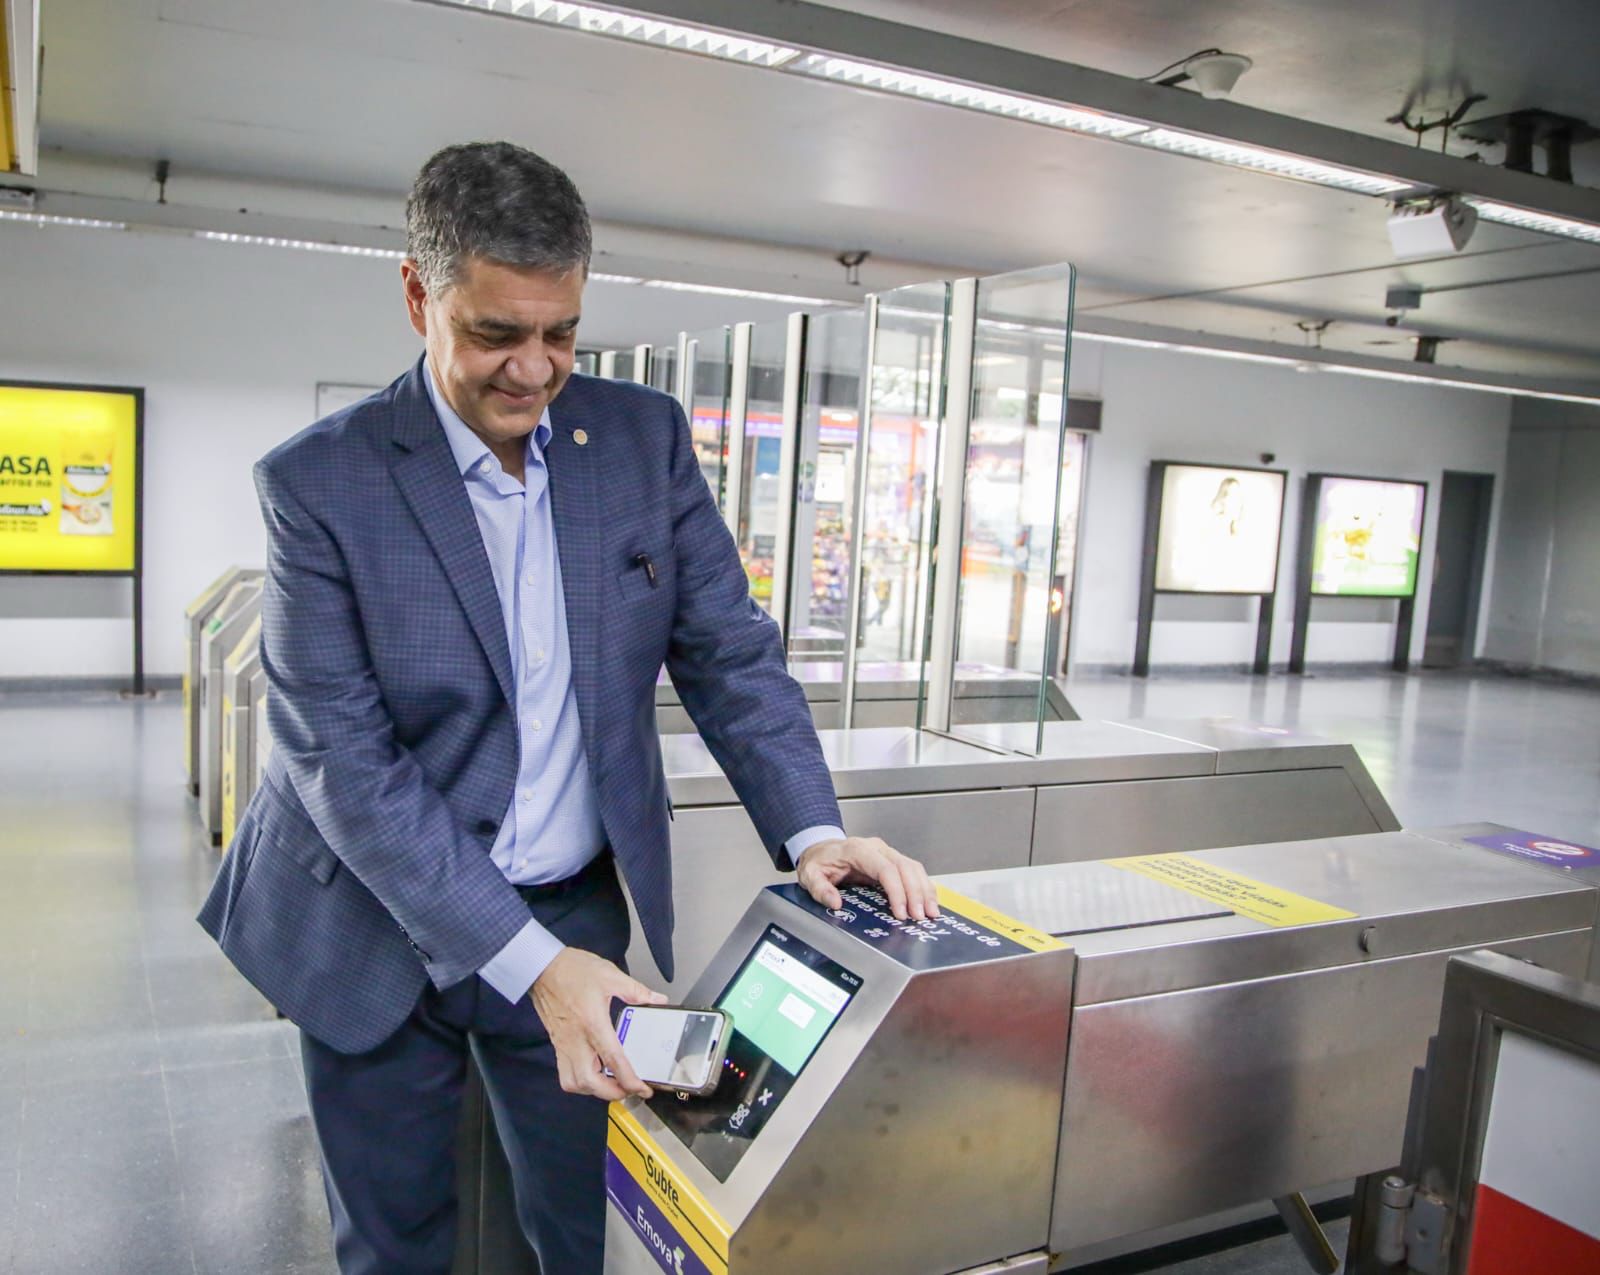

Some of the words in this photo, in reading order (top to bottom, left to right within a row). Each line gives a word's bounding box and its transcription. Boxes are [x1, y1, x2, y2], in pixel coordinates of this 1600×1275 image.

[873, 912, 902, 925] con
[899, 925, 938, 942] NFC
[976, 935, 1001, 947] de
[646, 1154, 679, 1203] Subte
[636, 1204, 673, 1265] Emova
